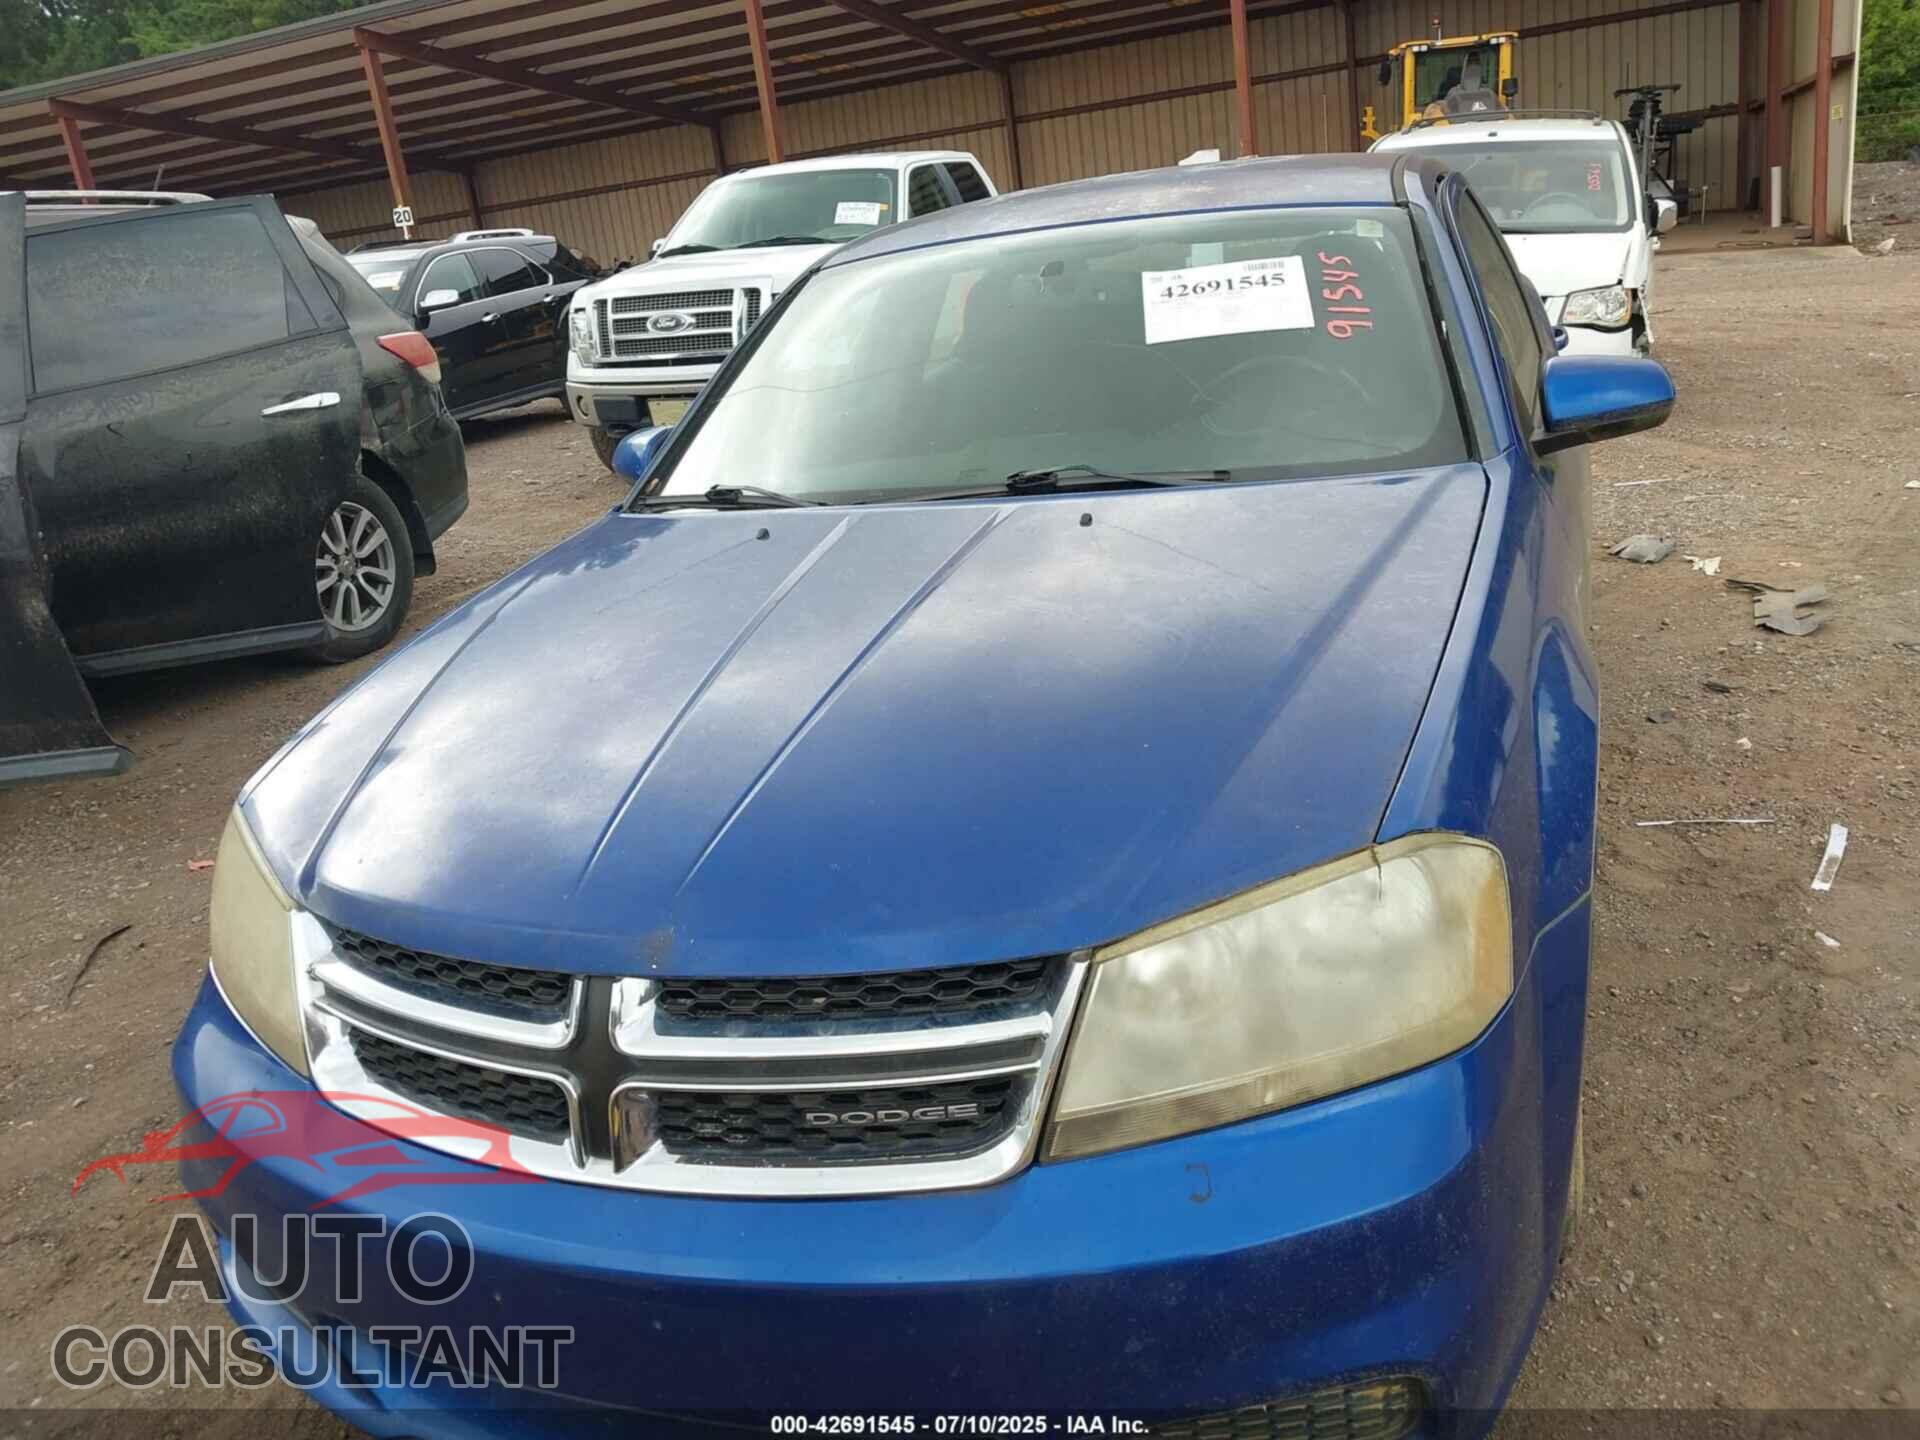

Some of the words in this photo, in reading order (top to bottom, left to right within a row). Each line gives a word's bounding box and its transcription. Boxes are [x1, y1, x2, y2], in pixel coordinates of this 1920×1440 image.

[394, 210, 411, 224] 20
[1160, 272, 1286, 299] 42691545
[1318, 251, 1373, 338] 91545
[805, 1103, 979, 1125] DODGE
